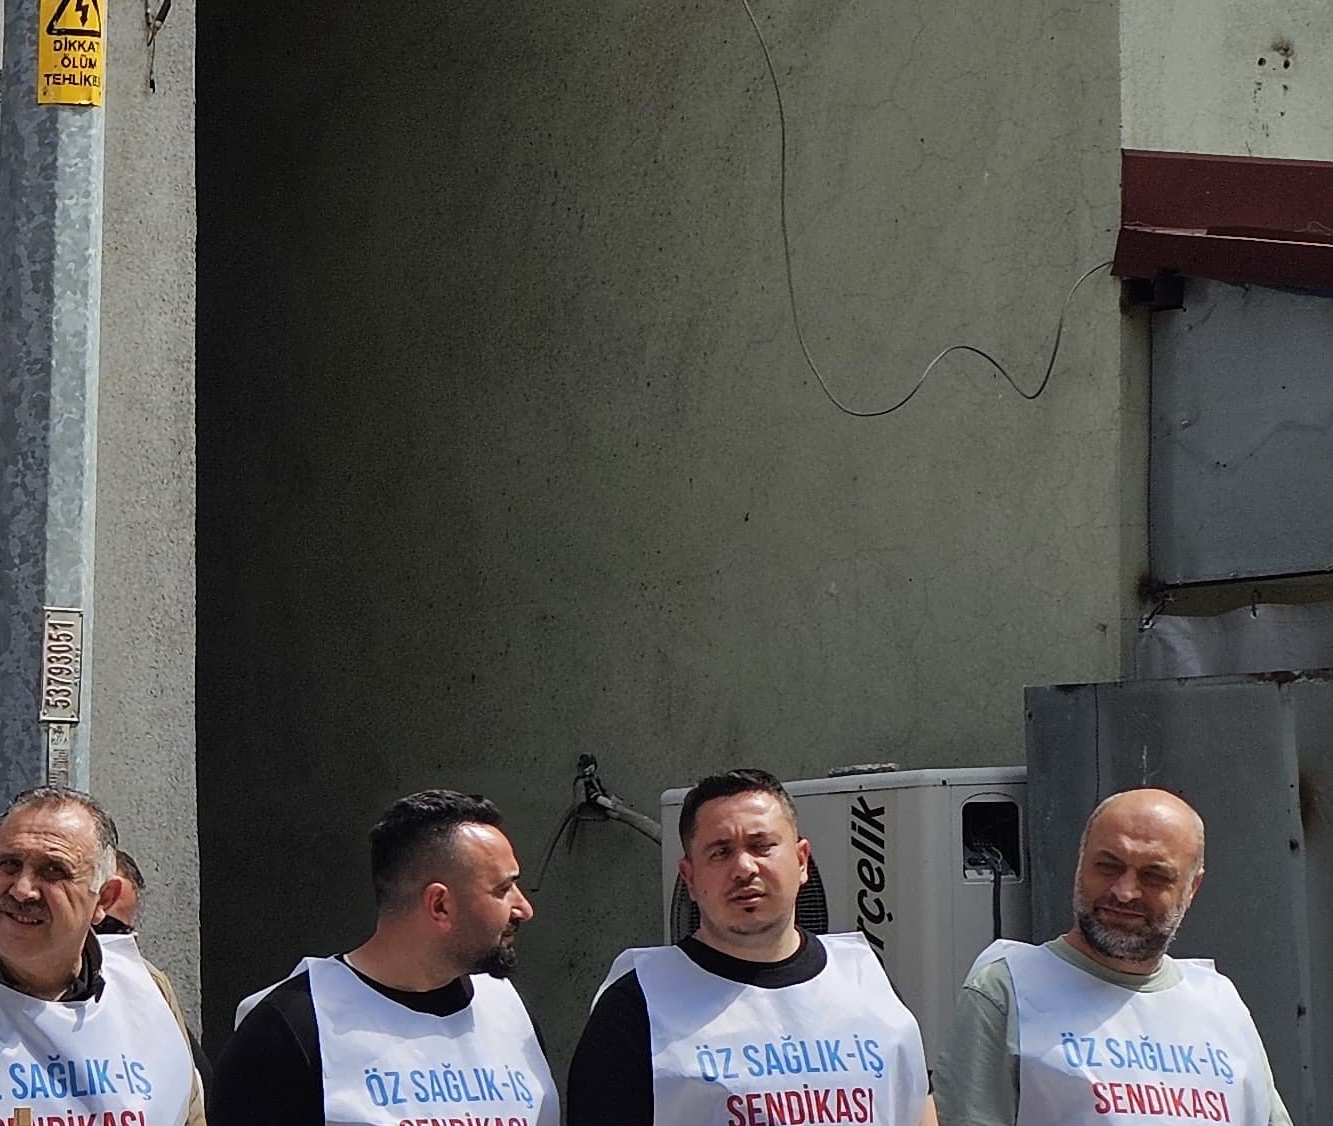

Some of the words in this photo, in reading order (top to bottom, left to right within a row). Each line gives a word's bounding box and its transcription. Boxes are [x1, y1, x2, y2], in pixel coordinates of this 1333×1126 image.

[46, 620, 75, 709] 53793051
[851, 796, 893, 950] rçelik
[9, 1054, 152, 1101] SAĞLIK-İŞ
[696, 1044, 736, 1082] ÖZ
[745, 1033, 885, 1079] SAĞLIK-İŞ
[1060, 1032, 1101, 1068] ÖZ
[1112, 1034, 1234, 1085] SAĞLIK-İŞ
[365, 1067, 404, 1106] ÖZ
[412, 1062, 533, 1109] SAĞLIK-İŞ
[1093, 1078, 1230, 1123] SENDİKASI
